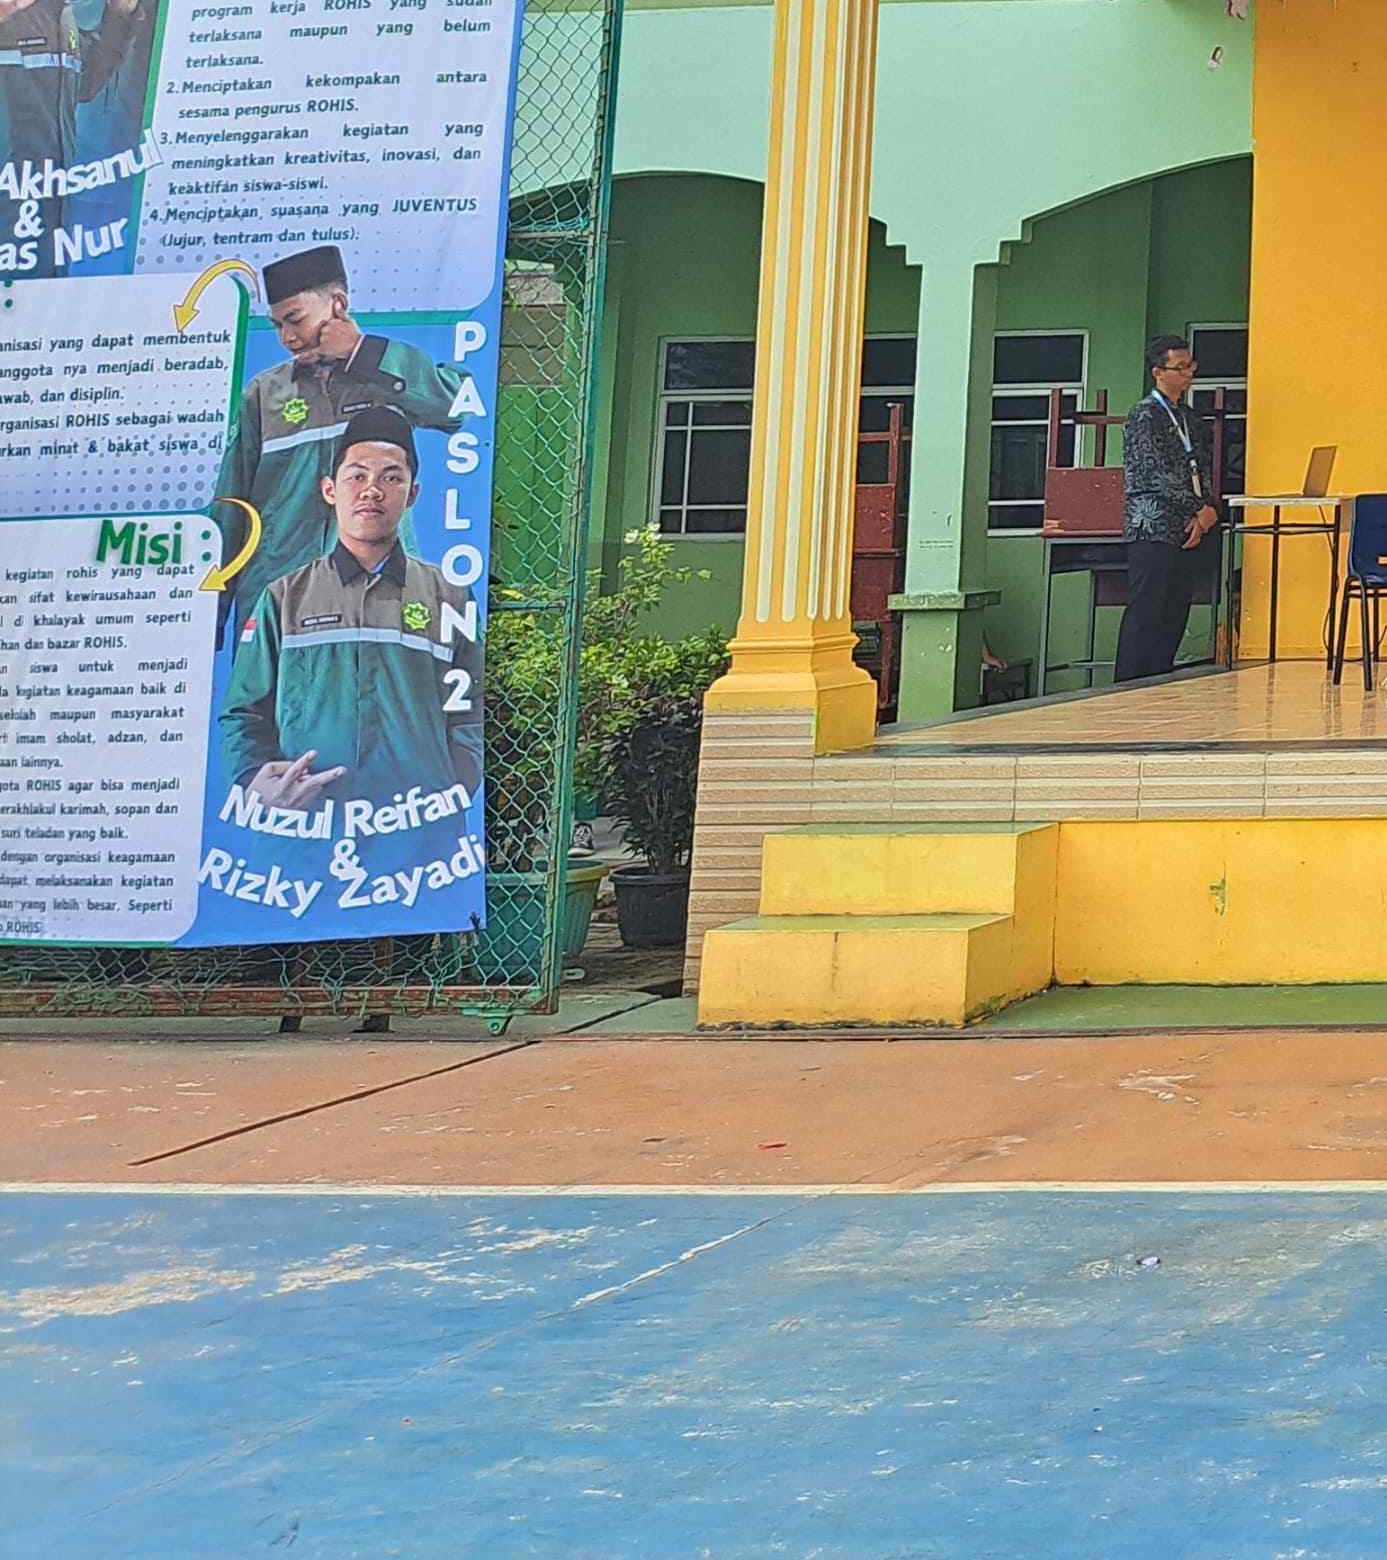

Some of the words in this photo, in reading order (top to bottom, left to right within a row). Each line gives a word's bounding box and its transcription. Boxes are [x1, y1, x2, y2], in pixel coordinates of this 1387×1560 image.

[192, 3, 253, 20] program
[271, 2, 306, 16] kerja
[306, 73, 400, 87] kekompakan
[436, 71, 487, 83] antara
[179, 107, 229, 119] sesama
[234, 103, 301, 119] pengurus
[307, 99, 359, 112] ROHIS.
[14, 200, 45, 238] &
[53, 218, 128, 266] Nur
[96, 519, 181, 565] Misi
[442, 669, 472, 712] 2
[219, 784, 334, 840] Nuzul
[345, 782, 472, 838] Reifan
[199, 848, 322, 918] Rizky
[336, 835, 485, 909] Zayadi
[329, 838, 366, 881] &
